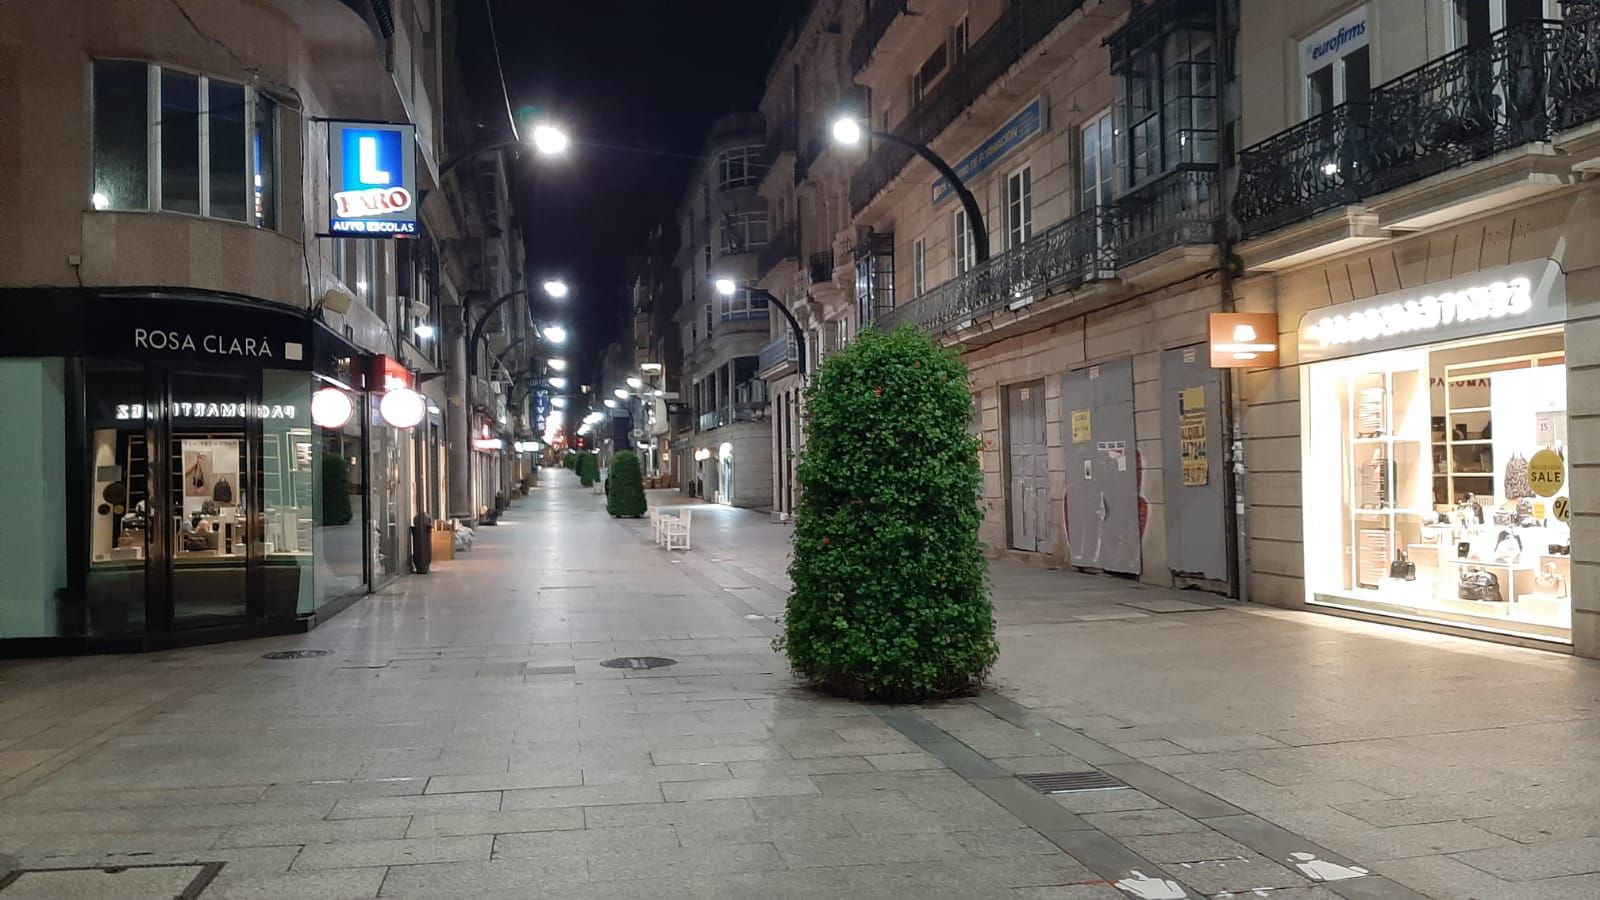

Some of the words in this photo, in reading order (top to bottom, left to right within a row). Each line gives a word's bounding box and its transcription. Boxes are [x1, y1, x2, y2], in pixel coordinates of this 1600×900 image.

[1312, 19, 1366, 60] eurofirms
[359, 136, 390, 185] L
[333, 221, 365, 231] AUTO
[366, 221, 415, 232] ESCOLAS
[134, 328, 197, 352] ROSA
[203, 334, 273, 358] CLARÁ
[1531, 471, 1561, 482] SALE
